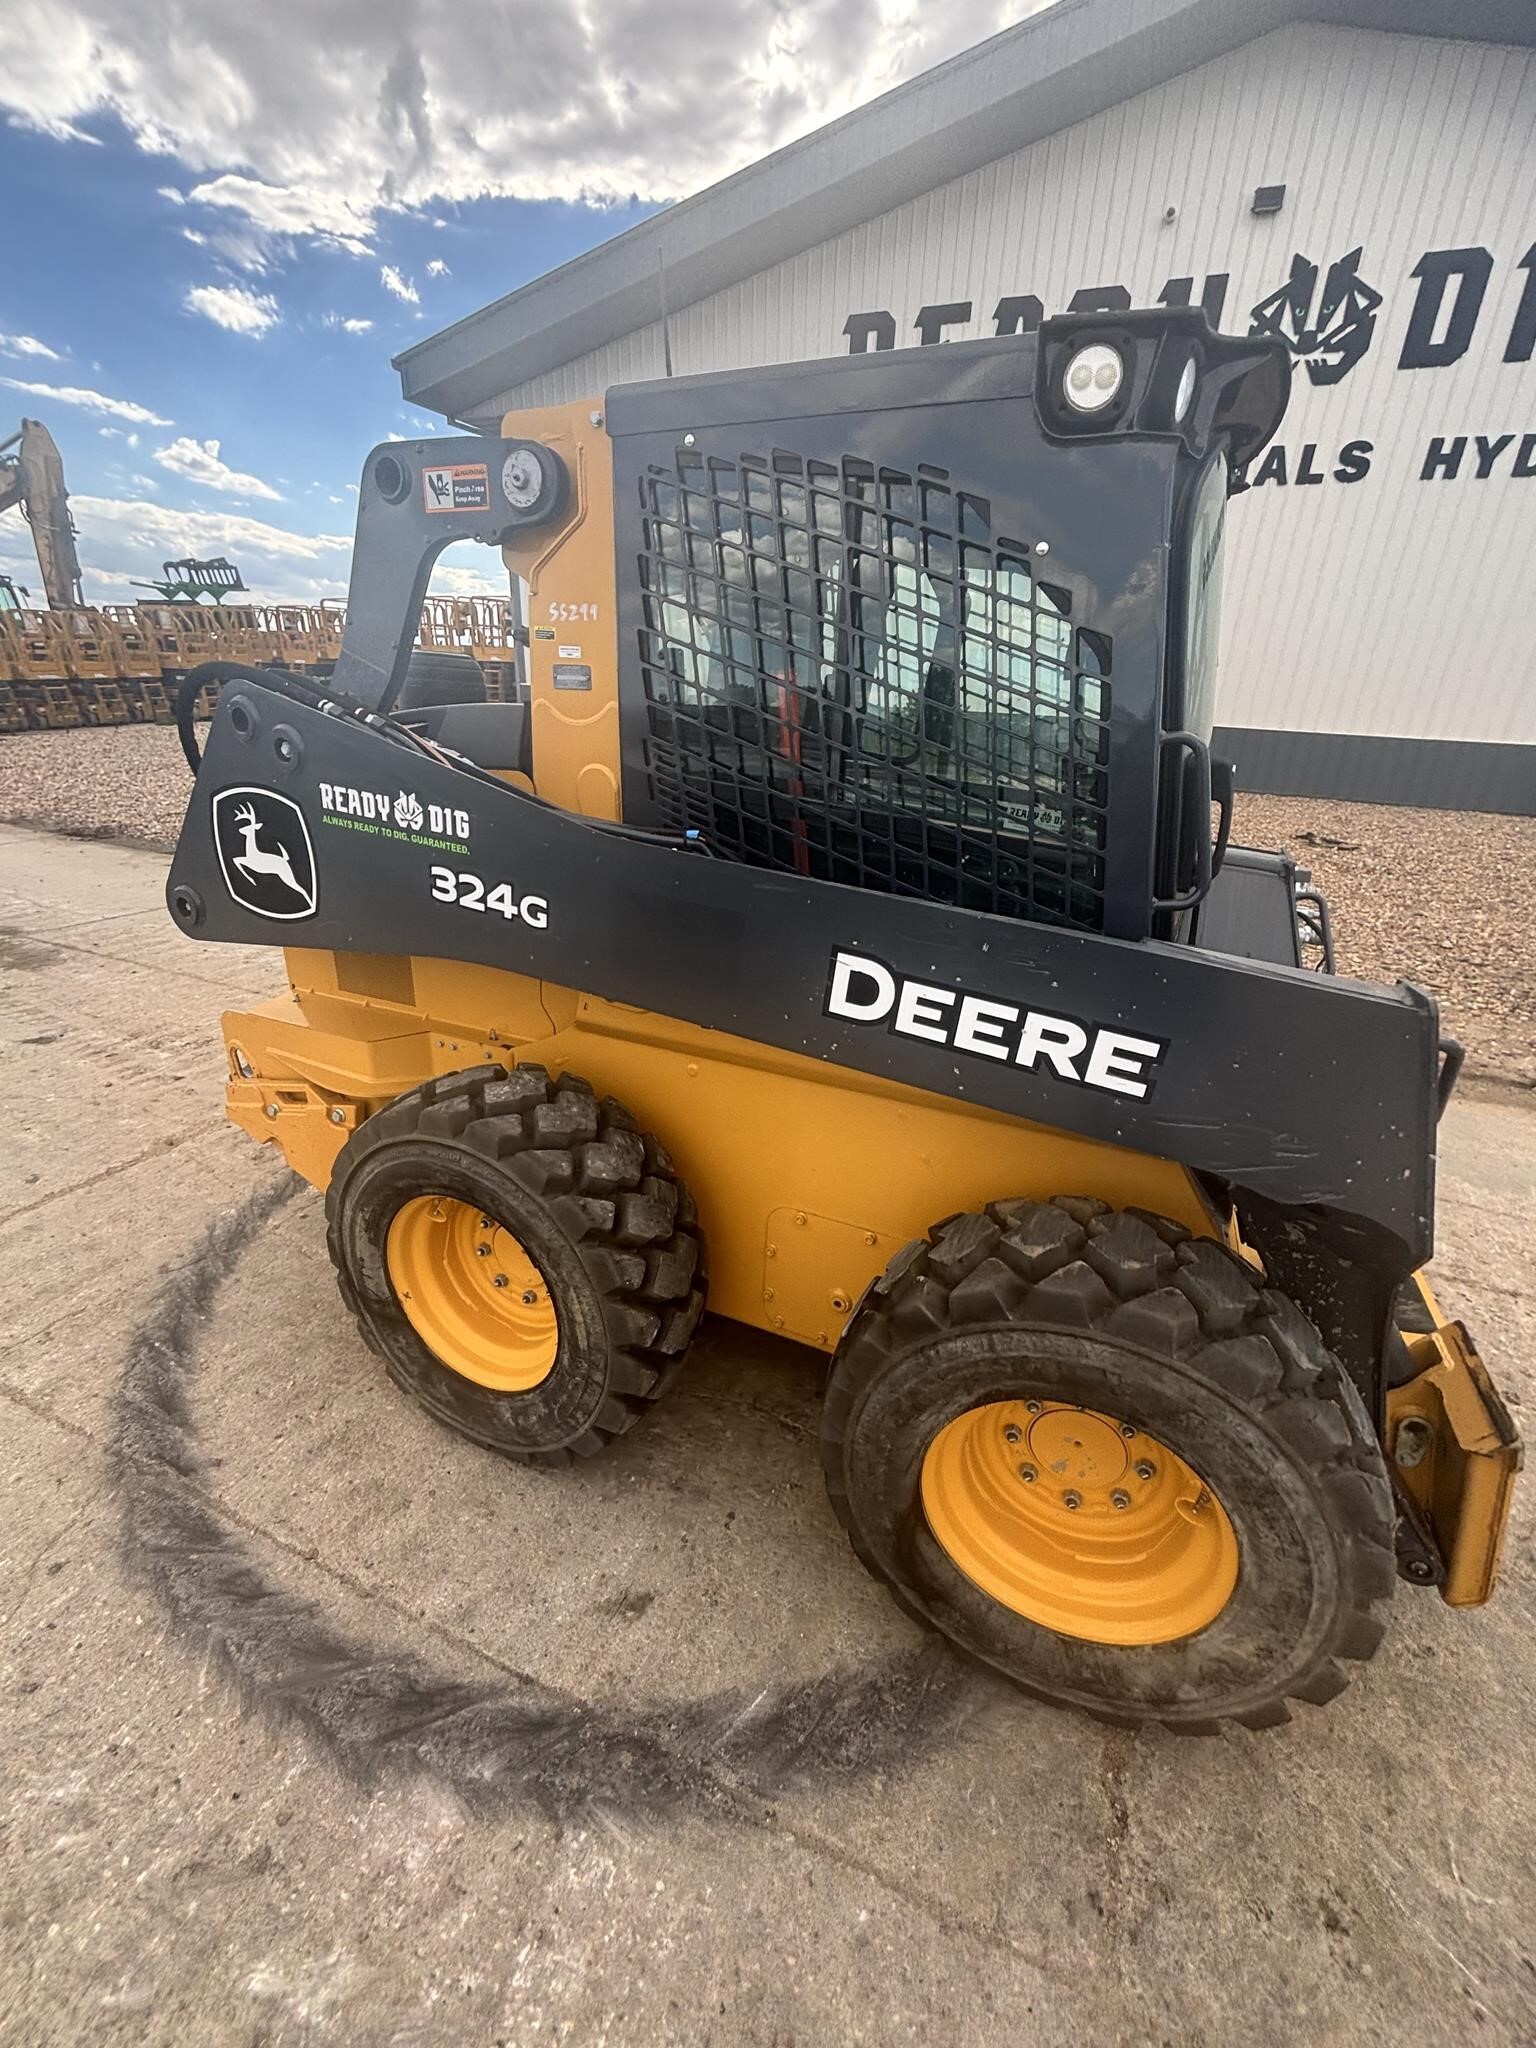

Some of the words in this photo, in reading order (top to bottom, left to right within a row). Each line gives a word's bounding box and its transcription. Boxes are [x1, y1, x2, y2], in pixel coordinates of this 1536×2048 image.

[319, 783, 390, 821] READY
[428, 805, 470, 839] DIG
[322, 815, 352, 829] ALWAYS
[354, 821, 379, 834] READY
[381, 828, 392, 837] TO
[393, 830, 410, 842] DIG.
[411, 834, 471, 855] GUARANTEED.
[430, 866, 548, 929] 324G
[828, 951, 1161, 1099] DEERE
